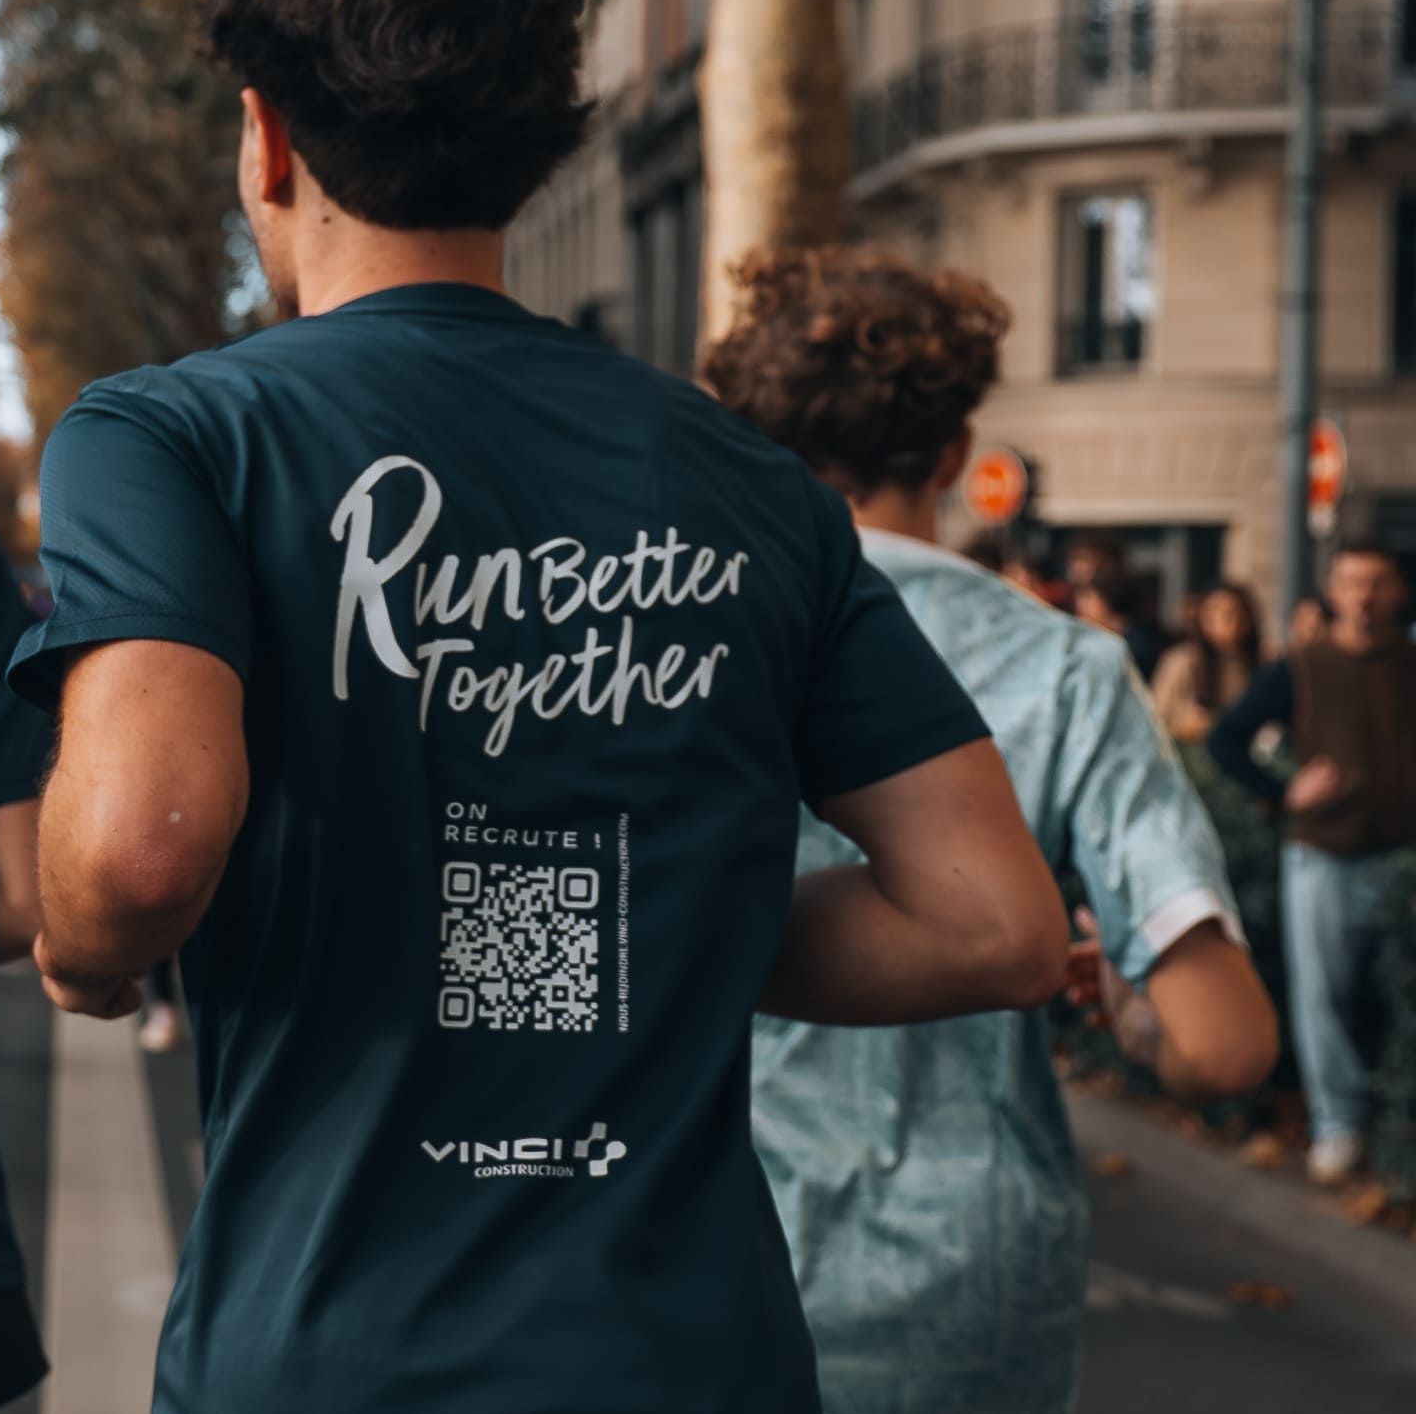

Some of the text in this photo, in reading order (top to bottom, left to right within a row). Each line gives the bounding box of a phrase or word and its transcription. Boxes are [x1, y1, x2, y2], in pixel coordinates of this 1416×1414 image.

[330, 455, 749, 700] Run Better
[416, 616, 728, 757] Together
[446, 802, 488, 821] ON
[444, 825, 579, 849] RECRUTE
[421, 1138, 563, 1162] VINCI
[474, 1164, 575, 1179] CONSTRUCTION
